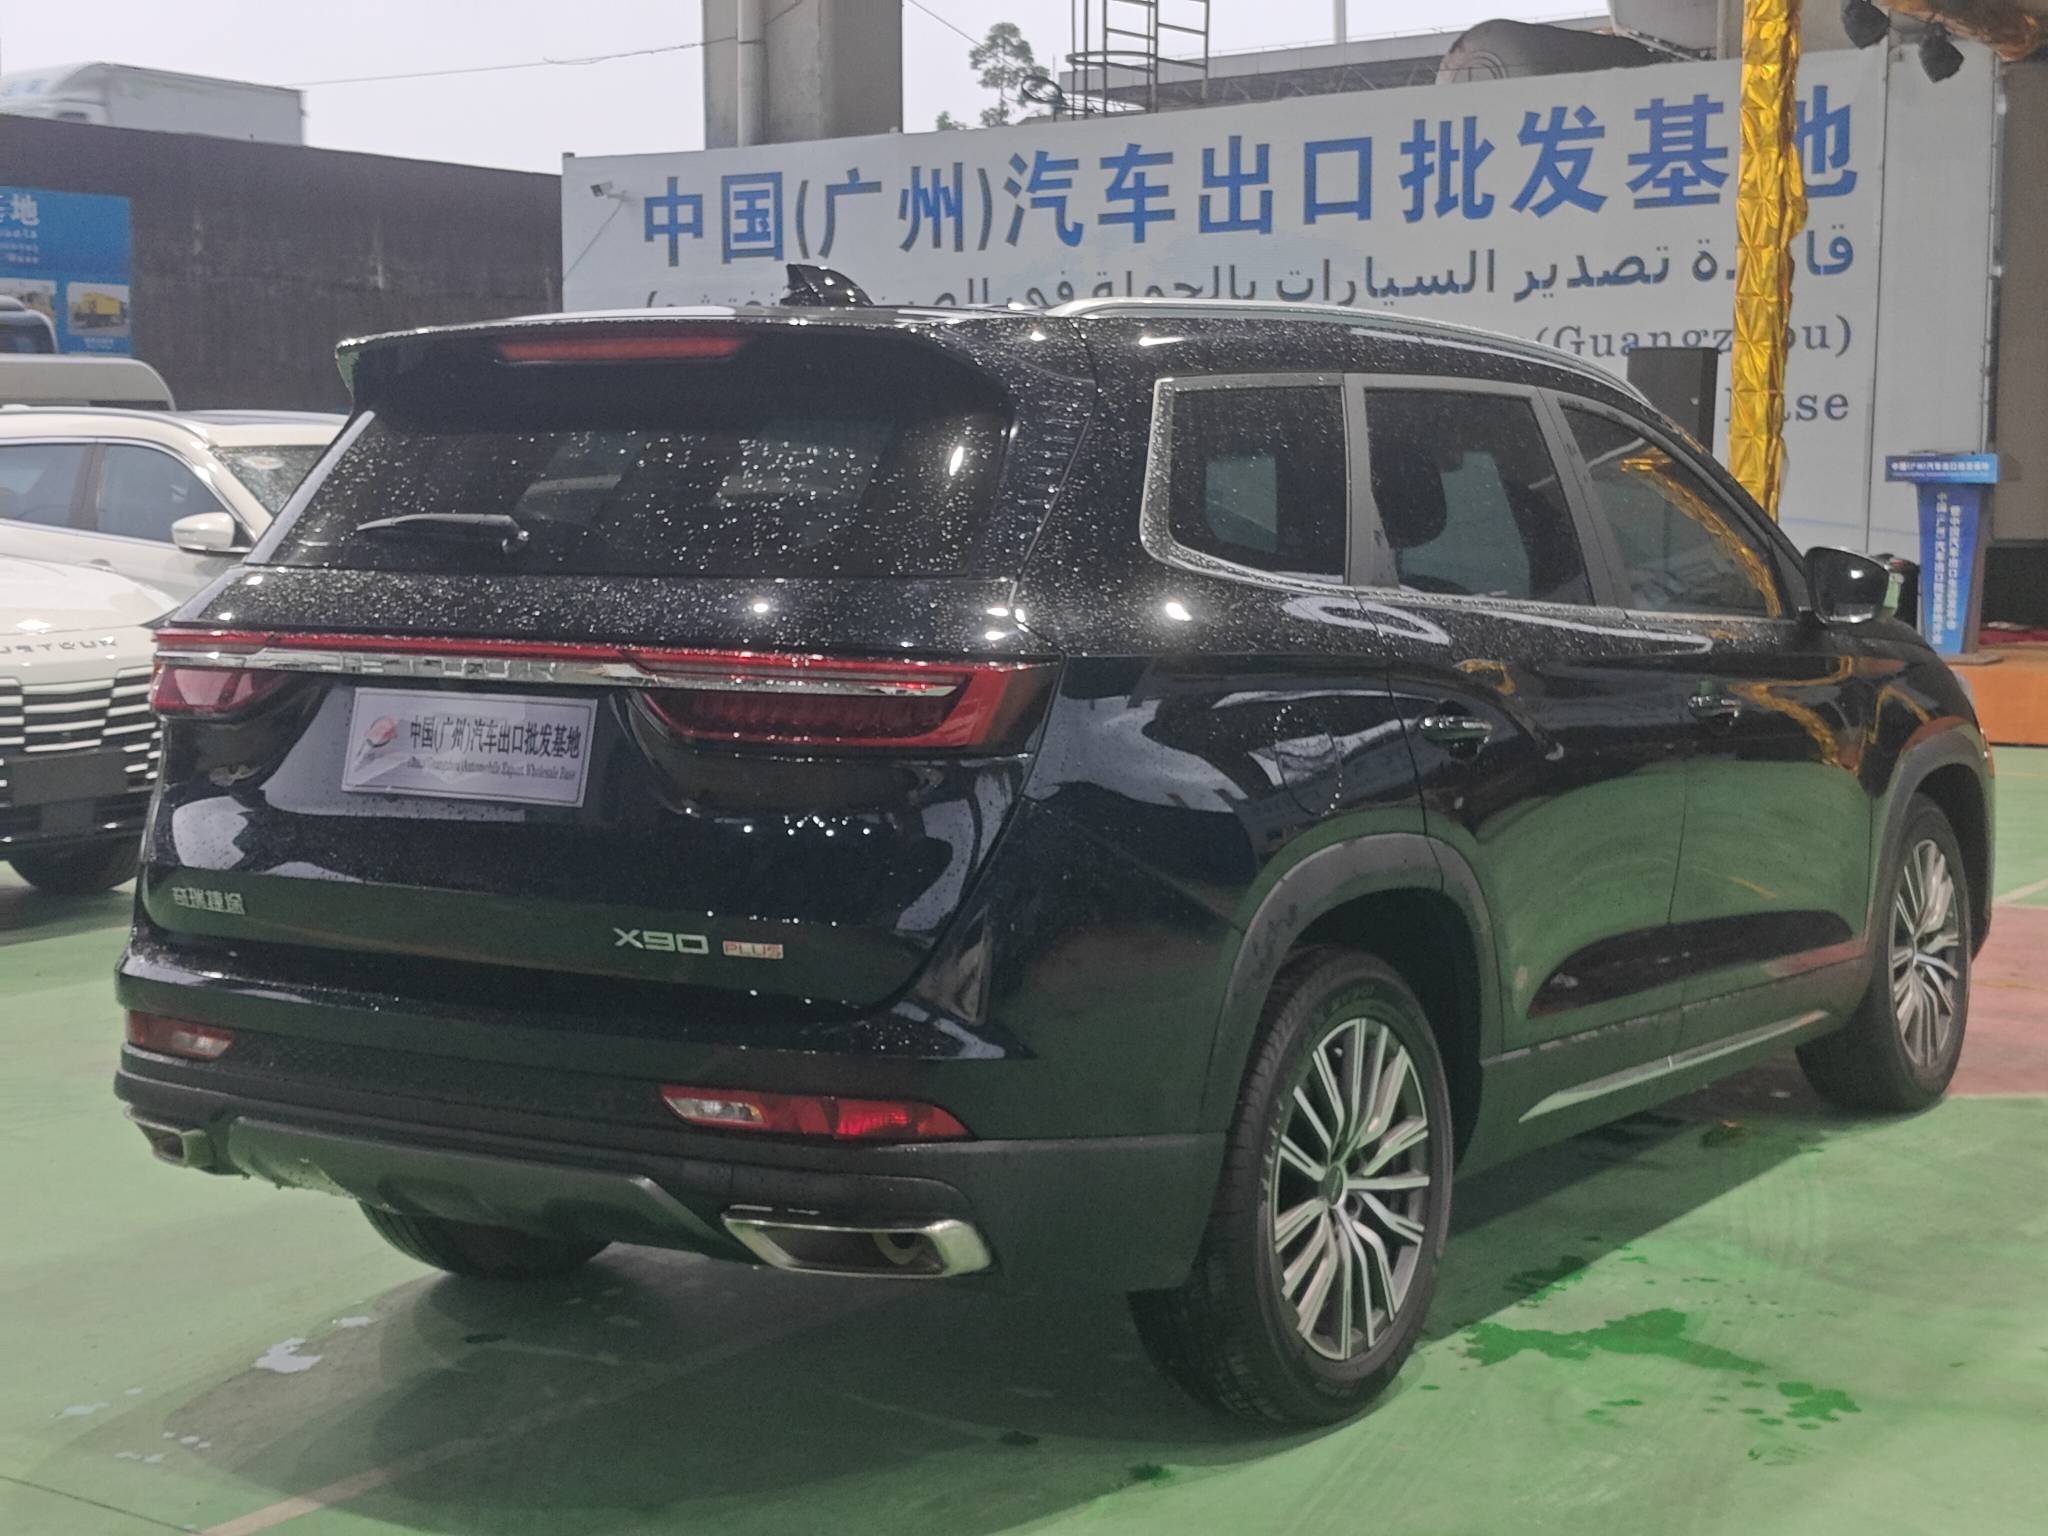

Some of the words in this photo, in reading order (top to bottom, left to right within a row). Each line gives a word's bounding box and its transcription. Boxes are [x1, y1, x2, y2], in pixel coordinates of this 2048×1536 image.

[1276, 248, 1496, 306] السيارات
[1513, 245, 1669, 302] تصدير
[410, 714, 582, 761] 中国(广州)汽车出口批发基地
[613, 926, 710, 955] X90
[722, 940, 785, 960] PLUS
